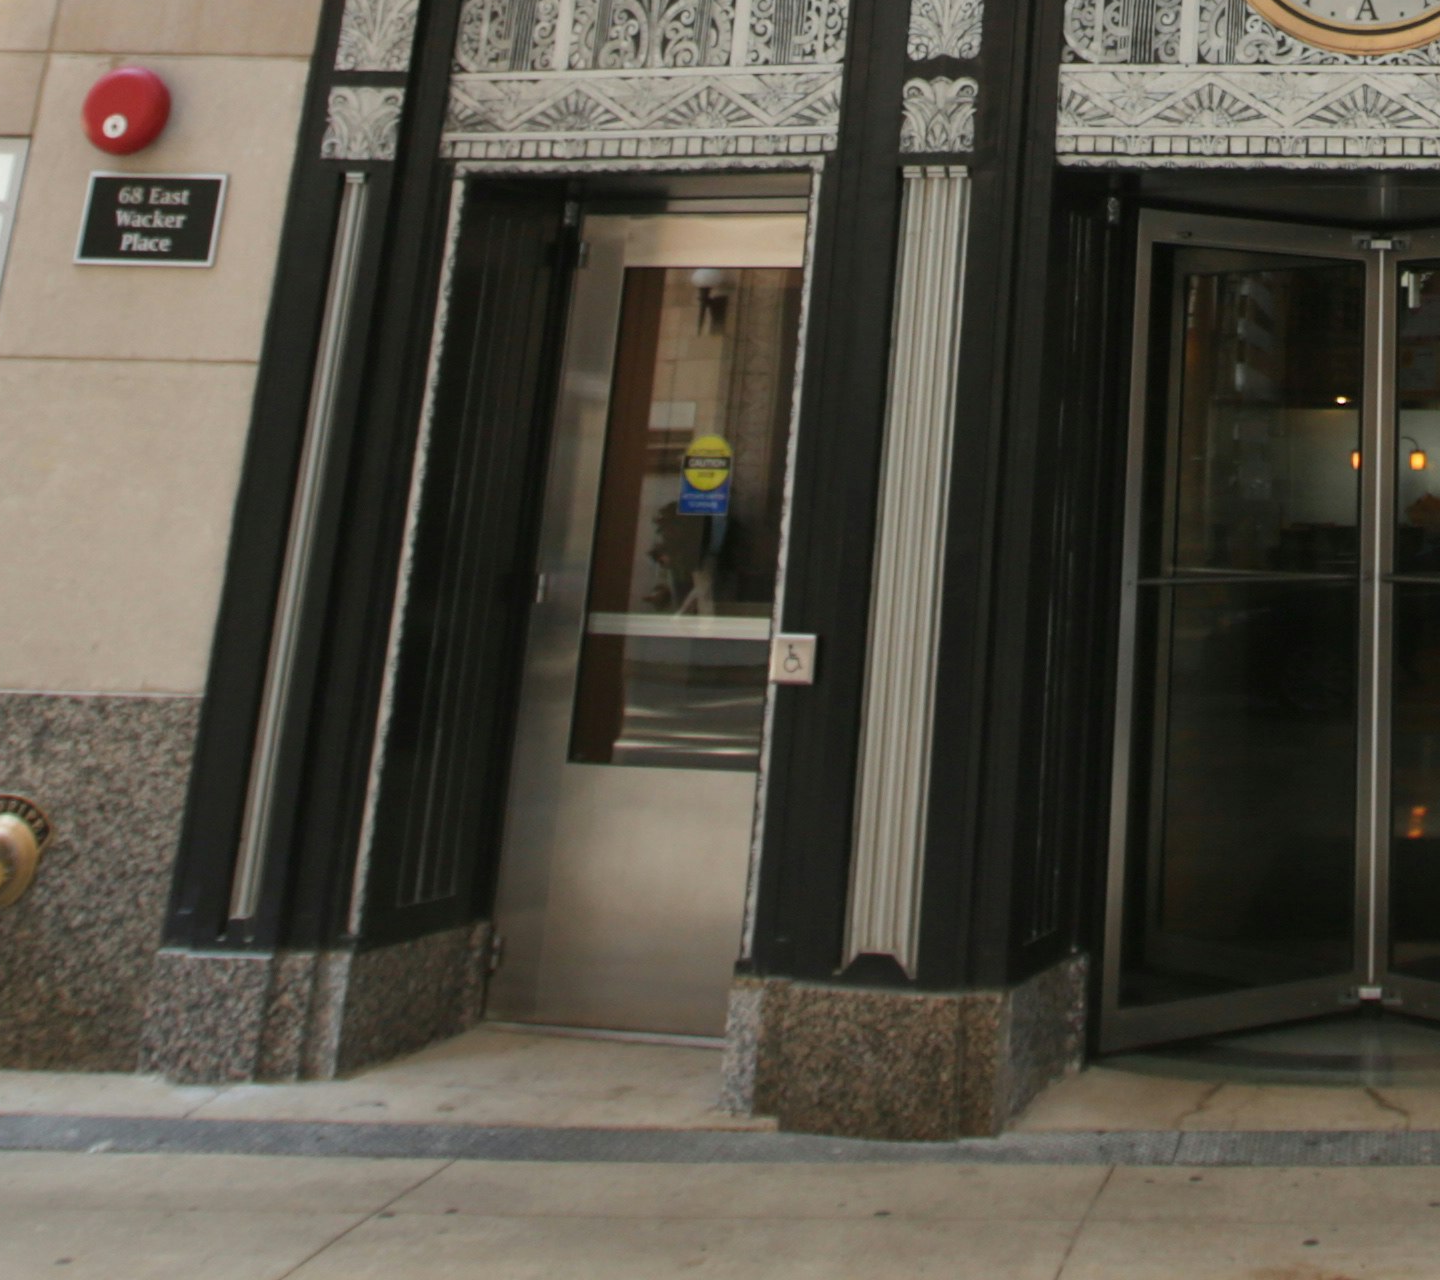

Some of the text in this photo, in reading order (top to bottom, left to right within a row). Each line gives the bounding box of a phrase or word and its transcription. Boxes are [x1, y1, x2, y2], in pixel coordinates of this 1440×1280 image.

[118, 186, 190, 206] 68 East
[116, 209, 187, 229] Wacker
[119, 232, 172, 252] Place
